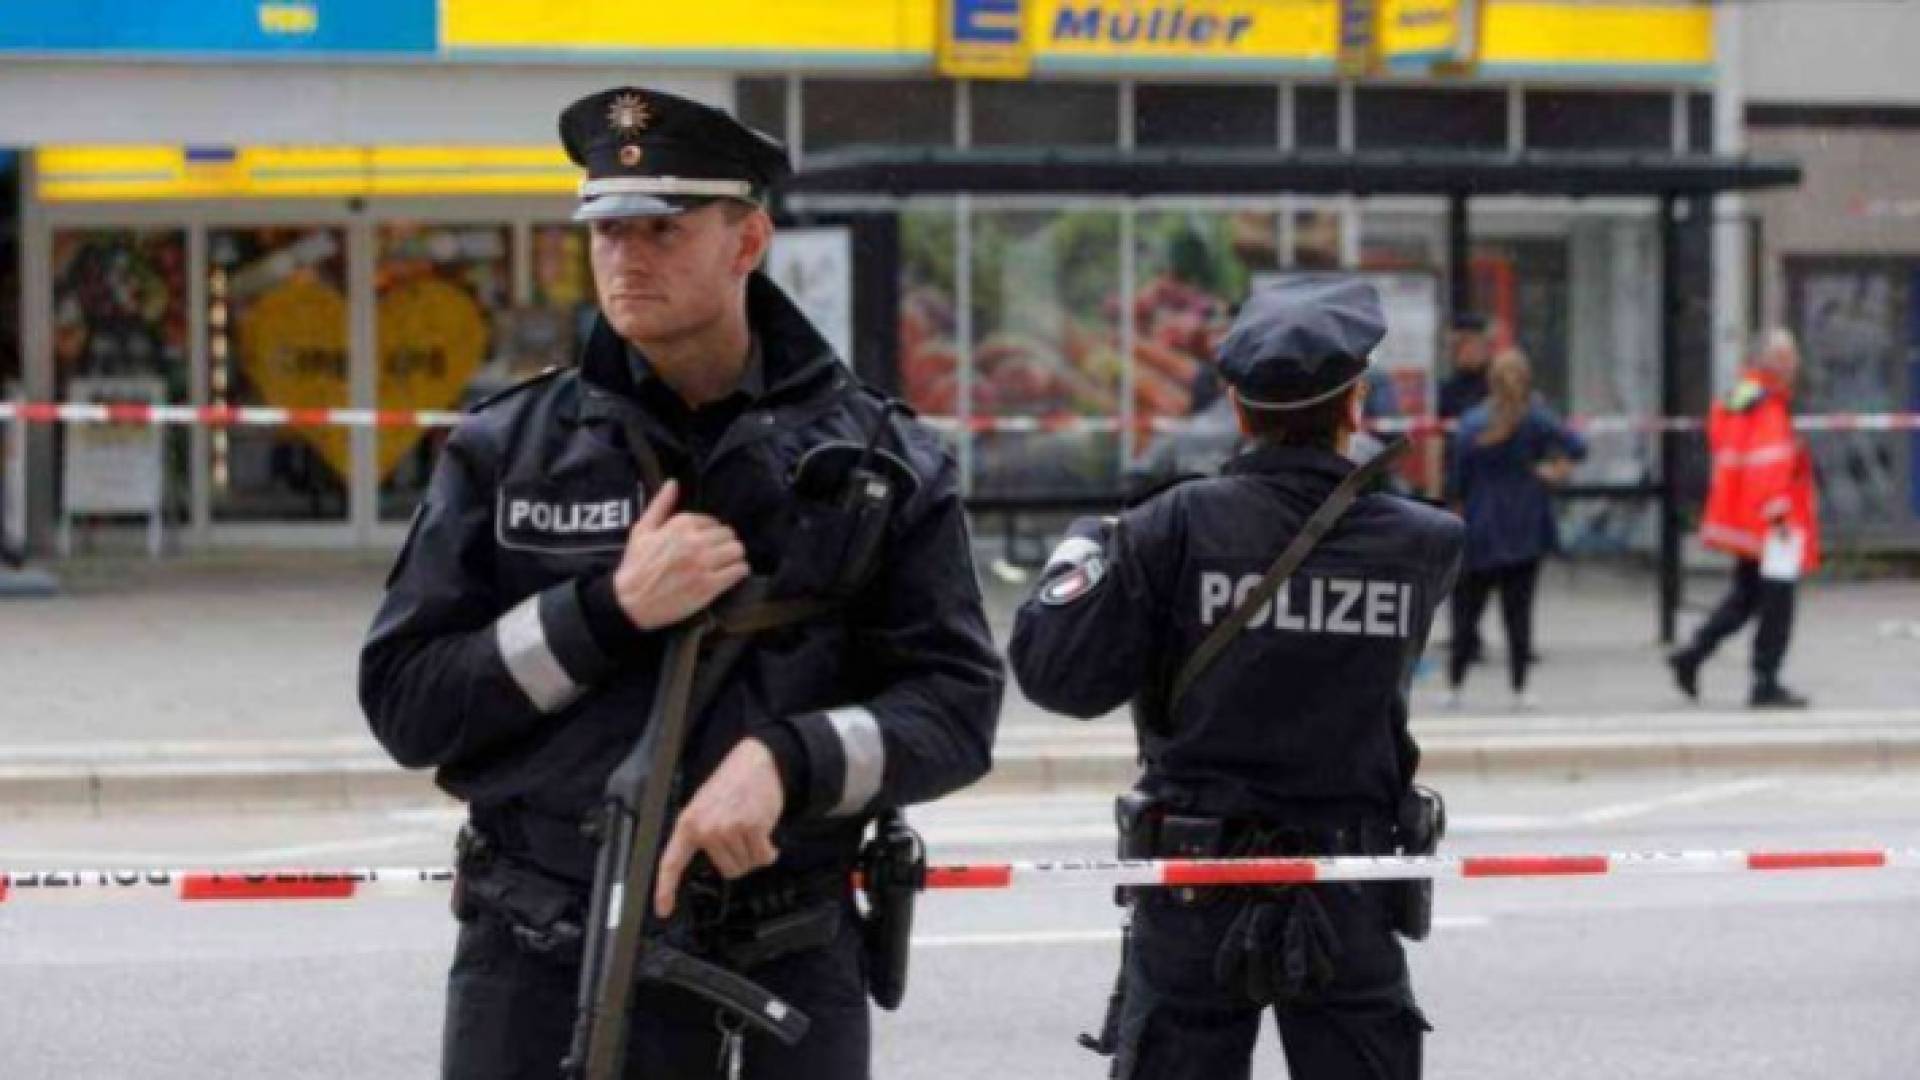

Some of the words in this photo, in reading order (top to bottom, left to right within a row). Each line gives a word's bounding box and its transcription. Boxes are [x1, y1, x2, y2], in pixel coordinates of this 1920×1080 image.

[1053, 5, 1253, 43] Müller
[510, 498, 631, 533] POLIZEI
[1200, 571, 1411, 638] POLIZEI
